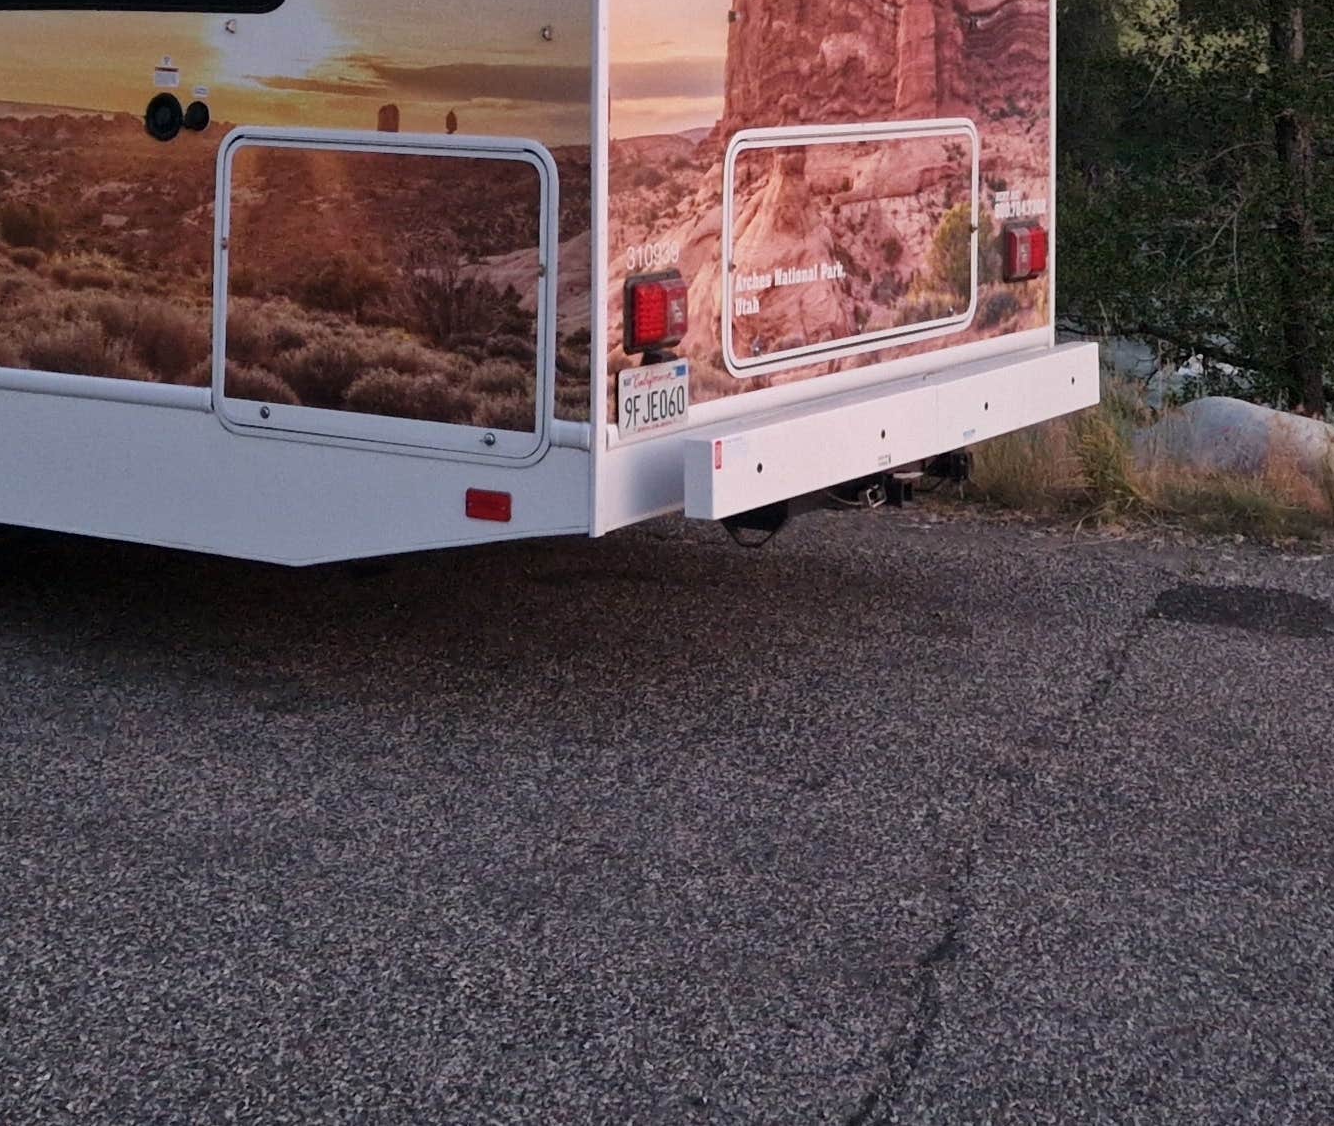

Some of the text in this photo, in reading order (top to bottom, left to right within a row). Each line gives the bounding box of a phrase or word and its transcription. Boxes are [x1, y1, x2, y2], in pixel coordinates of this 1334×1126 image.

[734, 272, 772, 292] Arches
[774, 264, 818, 287] National
[735, 296, 760, 316] Utah
